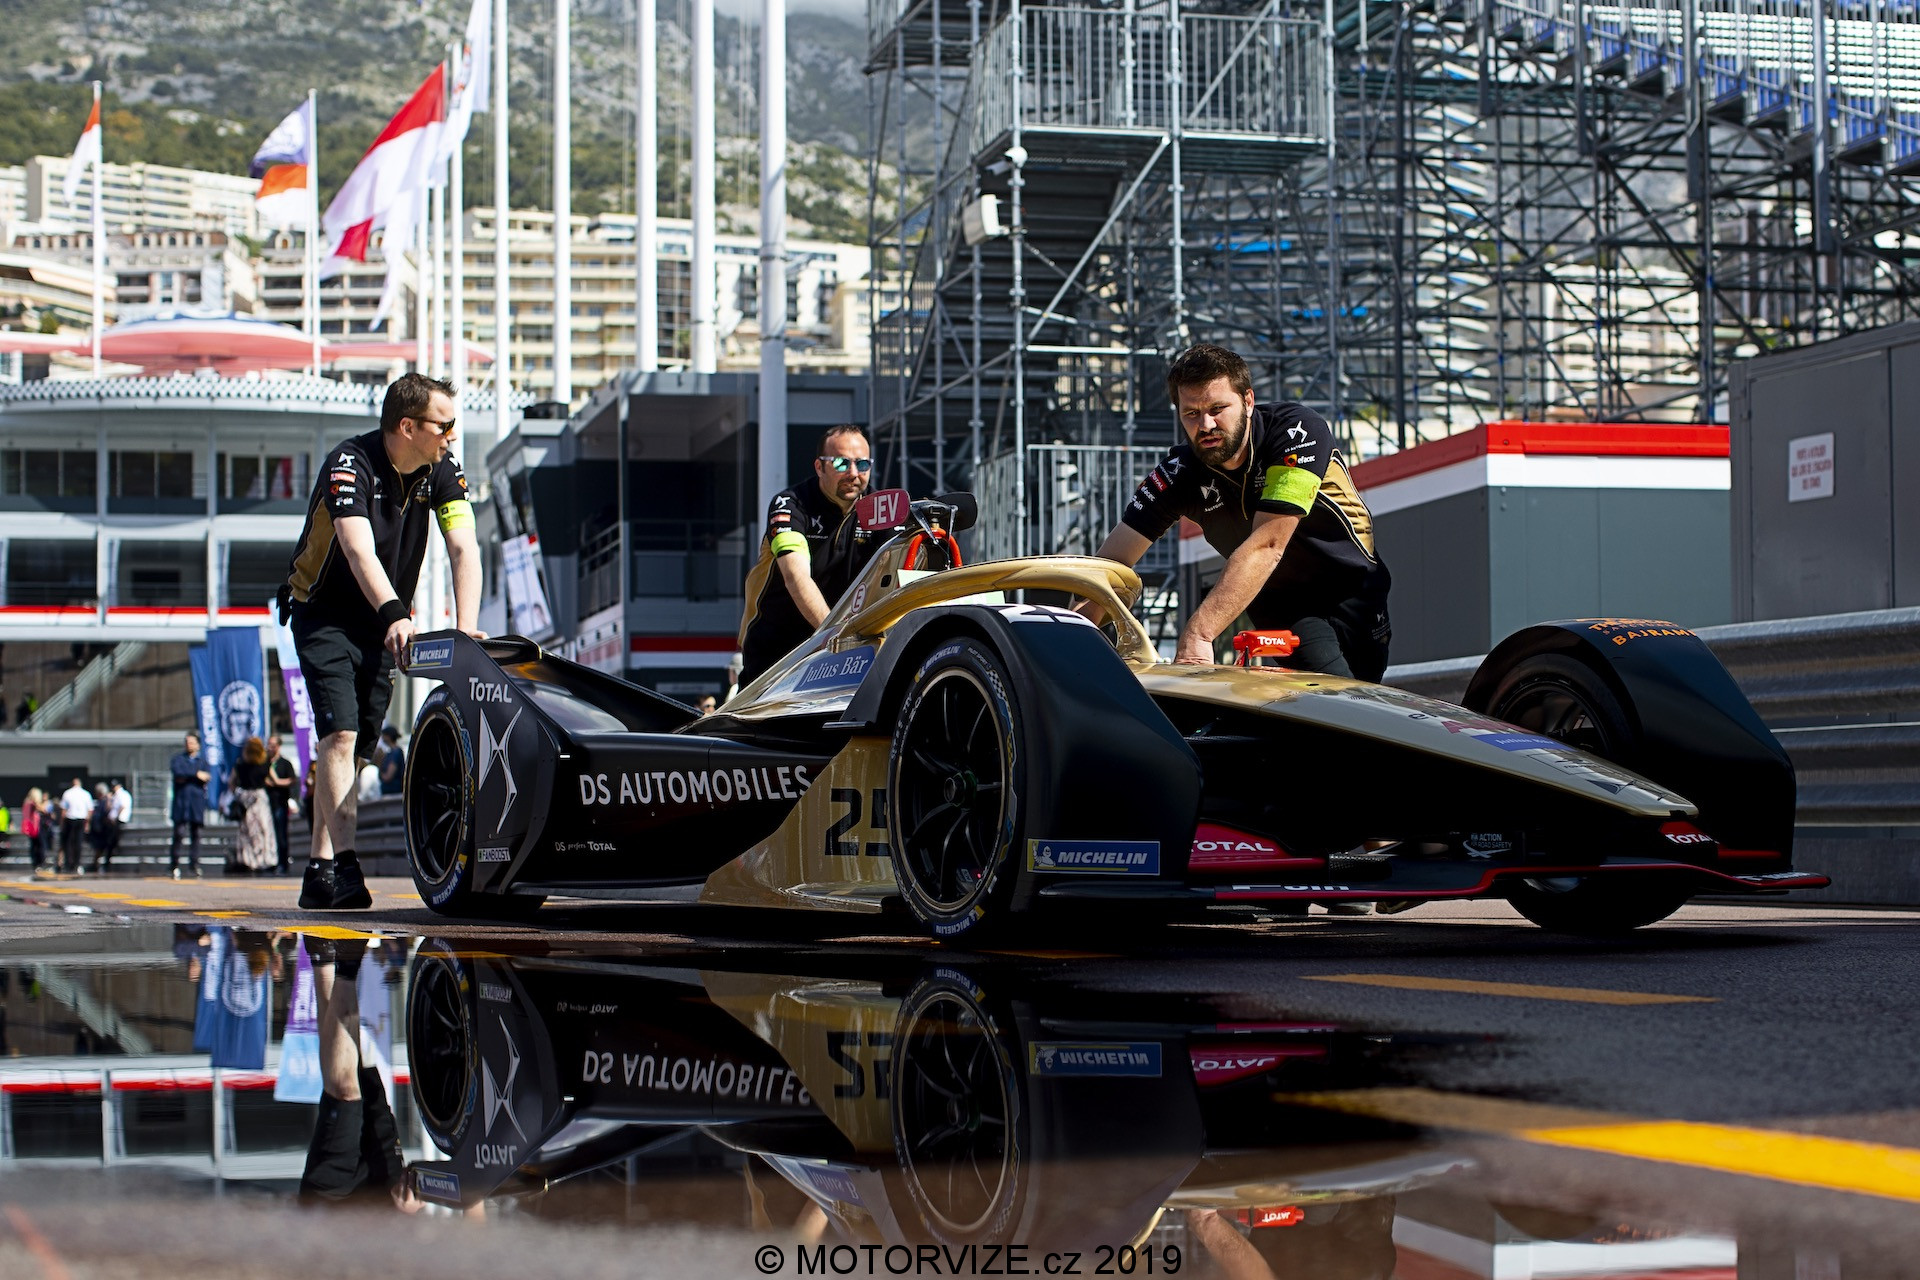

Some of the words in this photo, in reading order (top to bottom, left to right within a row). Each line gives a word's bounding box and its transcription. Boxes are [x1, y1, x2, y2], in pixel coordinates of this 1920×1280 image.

[868, 492, 899, 526] JEV
[1257, 635, 1286, 646] TOTAL
[419, 648, 450, 661] MICHELIN
[800, 662, 839, 687] Julius
[840, 655, 869, 677] Bär
[468, 676, 513, 704] TOTAL
[579, 773, 611, 805] DS
[619, 764, 812, 804] AUTOMOBILES
[555, 841, 566, 852] DS
[587, 840, 617, 851] TOTAL
[1191, 839, 1274, 852] OTAL
[1057, 850, 1149, 865] MICHELIN
